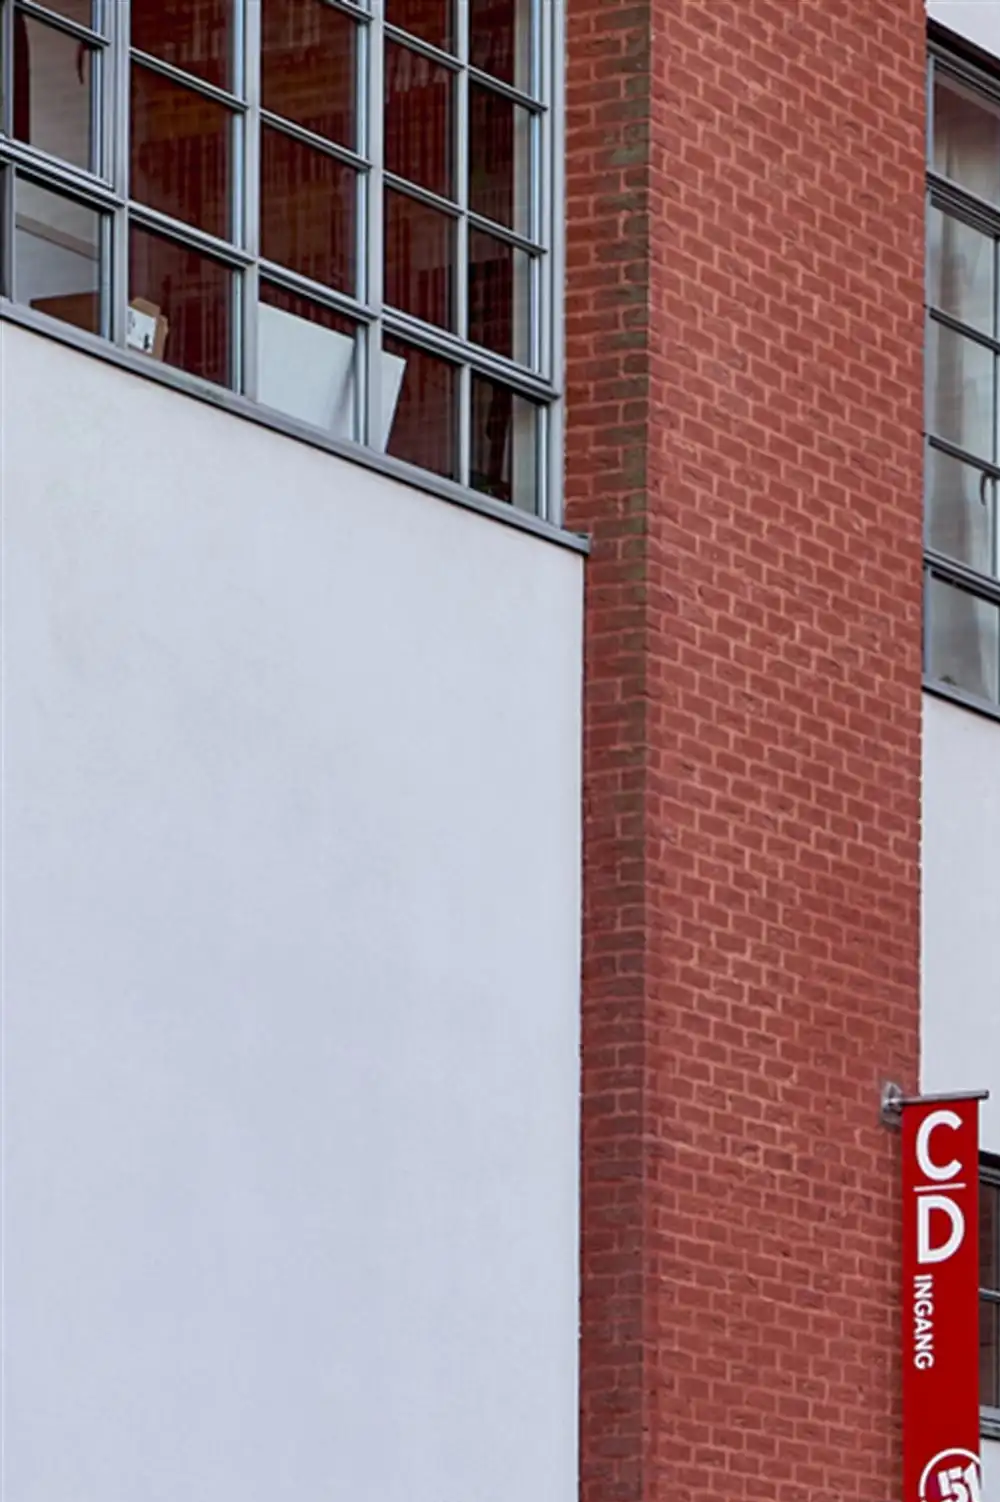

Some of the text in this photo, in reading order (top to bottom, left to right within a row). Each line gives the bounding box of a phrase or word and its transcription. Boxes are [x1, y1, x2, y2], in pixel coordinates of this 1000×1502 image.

[916, 1110, 962, 1181] C
[917, 1195, 965, 1264] D
[913, 1274, 935, 1370] INGANG
